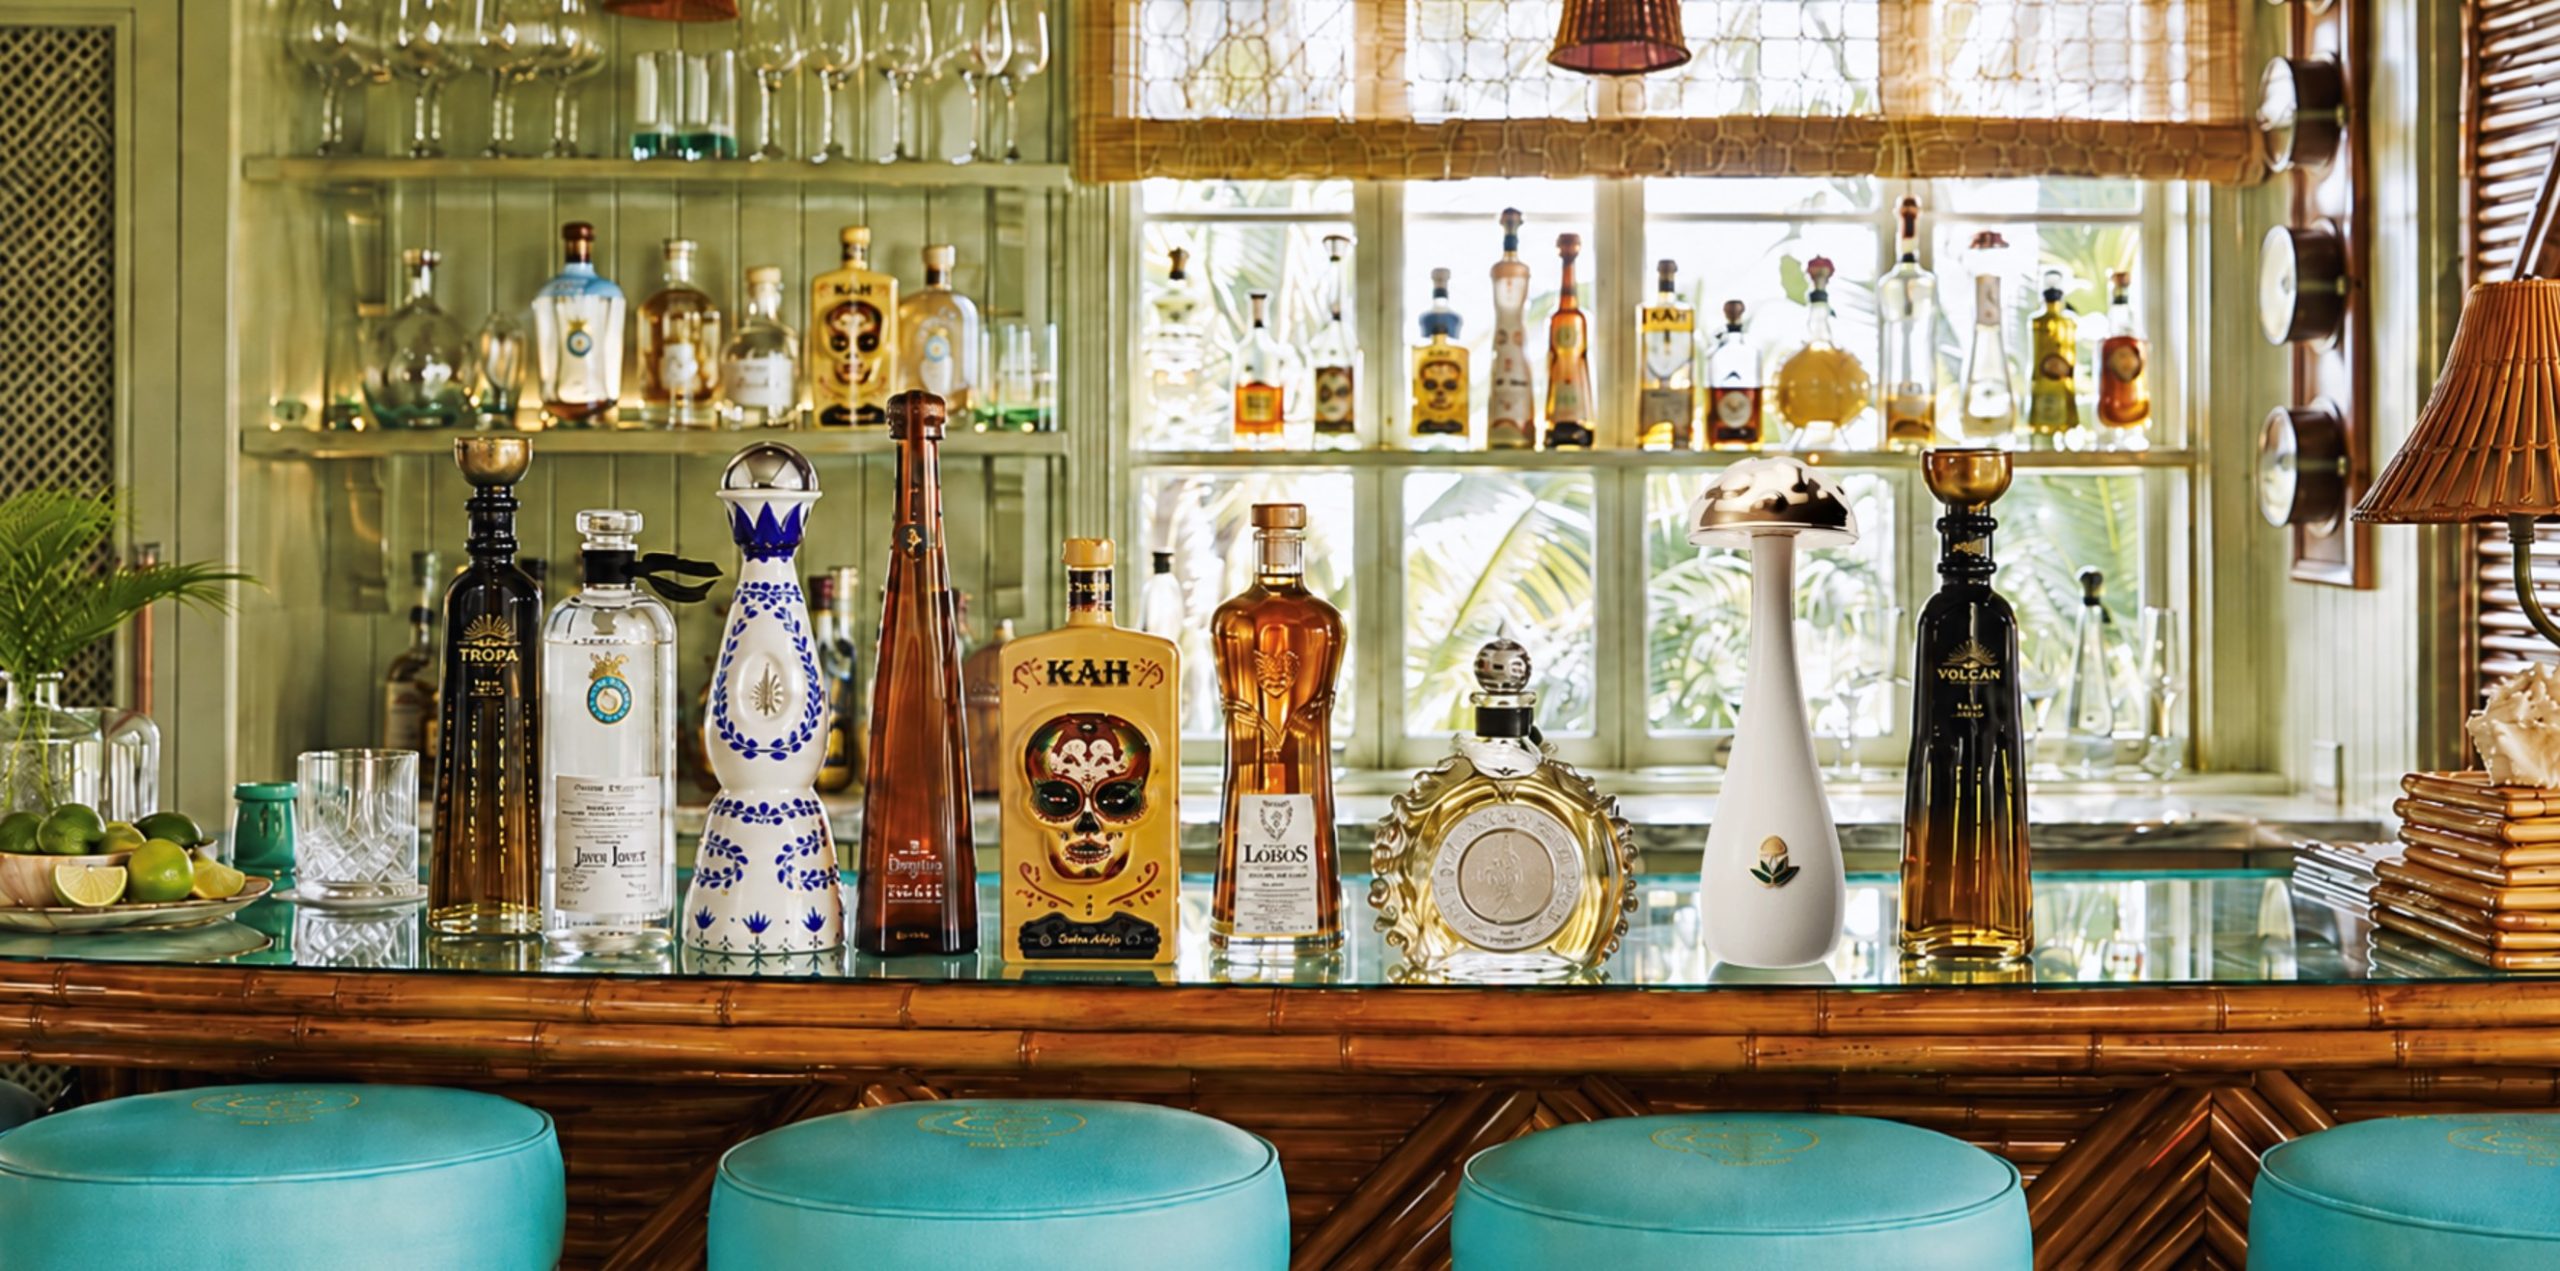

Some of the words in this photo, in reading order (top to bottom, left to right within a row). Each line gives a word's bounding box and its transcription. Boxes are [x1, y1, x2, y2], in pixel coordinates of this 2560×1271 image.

[459, 648, 519, 662] TROPA
[1047, 659, 1130, 686] KAH
[1937, 667, 2001, 680] VOLCÁN
[1243, 844, 1308, 864] LOBOS
